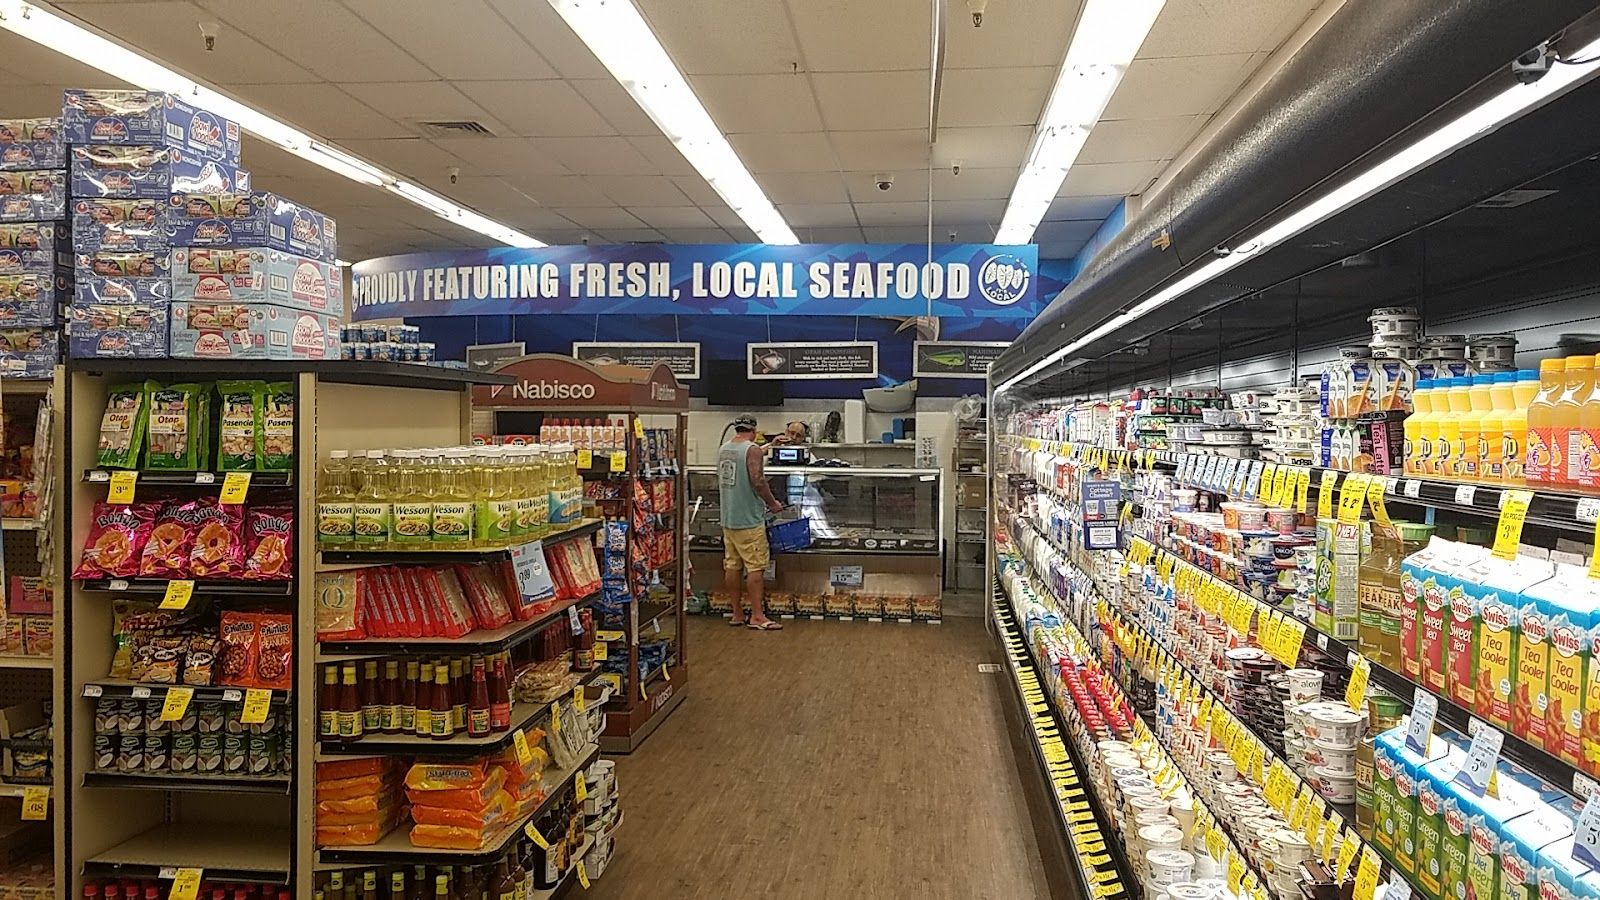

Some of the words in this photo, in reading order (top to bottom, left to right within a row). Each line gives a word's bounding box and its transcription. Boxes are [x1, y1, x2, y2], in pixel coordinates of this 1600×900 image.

[359, 269, 418, 307] PROUDLY
[423, 262, 559, 300] FEATURING
[570, 262, 681, 301] FRESH,
[692, 262, 798, 299] LOCAL
[809, 262, 970, 300] SEAFOOD
[986, 286, 1016, 301] LOCAL
[513, 379, 595, 399] Nabisco
[318, 503, 352, 515] Wesson
[395, 504, 430, 515] Wesson
[433, 504, 464, 514] Wesson
[98, 513, 140, 530] Bongo
[252, 517, 290, 535] Bongo
[1424, 588, 1443, 606] Swiss
[1452, 598, 1472, 616] Swiss
[1423, 611, 1443, 631] Sweet
[1483, 606, 1509, 627] Swiss
[1425, 627, 1437, 641] Tea
[1450, 621, 1472, 643] Sweet
[1522, 617, 1546, 638] Swiss
[1453, 639, 1466, 653] Tea
[1486, 634, 1503, 652] Tea
[1553, 628, 1581, 652] Swiss
[1480, 647, 1508, 667] Cooler
[1524, 646, 1541, 664] Tea
[1520, 660, 1545, 681] Cooler
[1555, 659, 1574, 679] Tea
[1551, 674, 1579, 696] Cooler
[1376, 760, 1393, 777] Swiss
[1373, 781, 1394, 806] Green
[1396, 775, 1411, 796] Swiss
[27, 803, 44, 813] .68
[1420, 790, 1438, 812] Swiss
[1392, 798, 1413, 825] Green
[1445, 808, 1466, 833] Swiss
[1416, 815, 1440, 844] Green
[1471, 824, 1494, 852] Swiss
[1441, 836, 1467, 866] Green
[1473, 854, 1488, 870] Diet
[1501, 852, 1527, 882] Swiss
[1504, 882, 1522, 900] Diet
